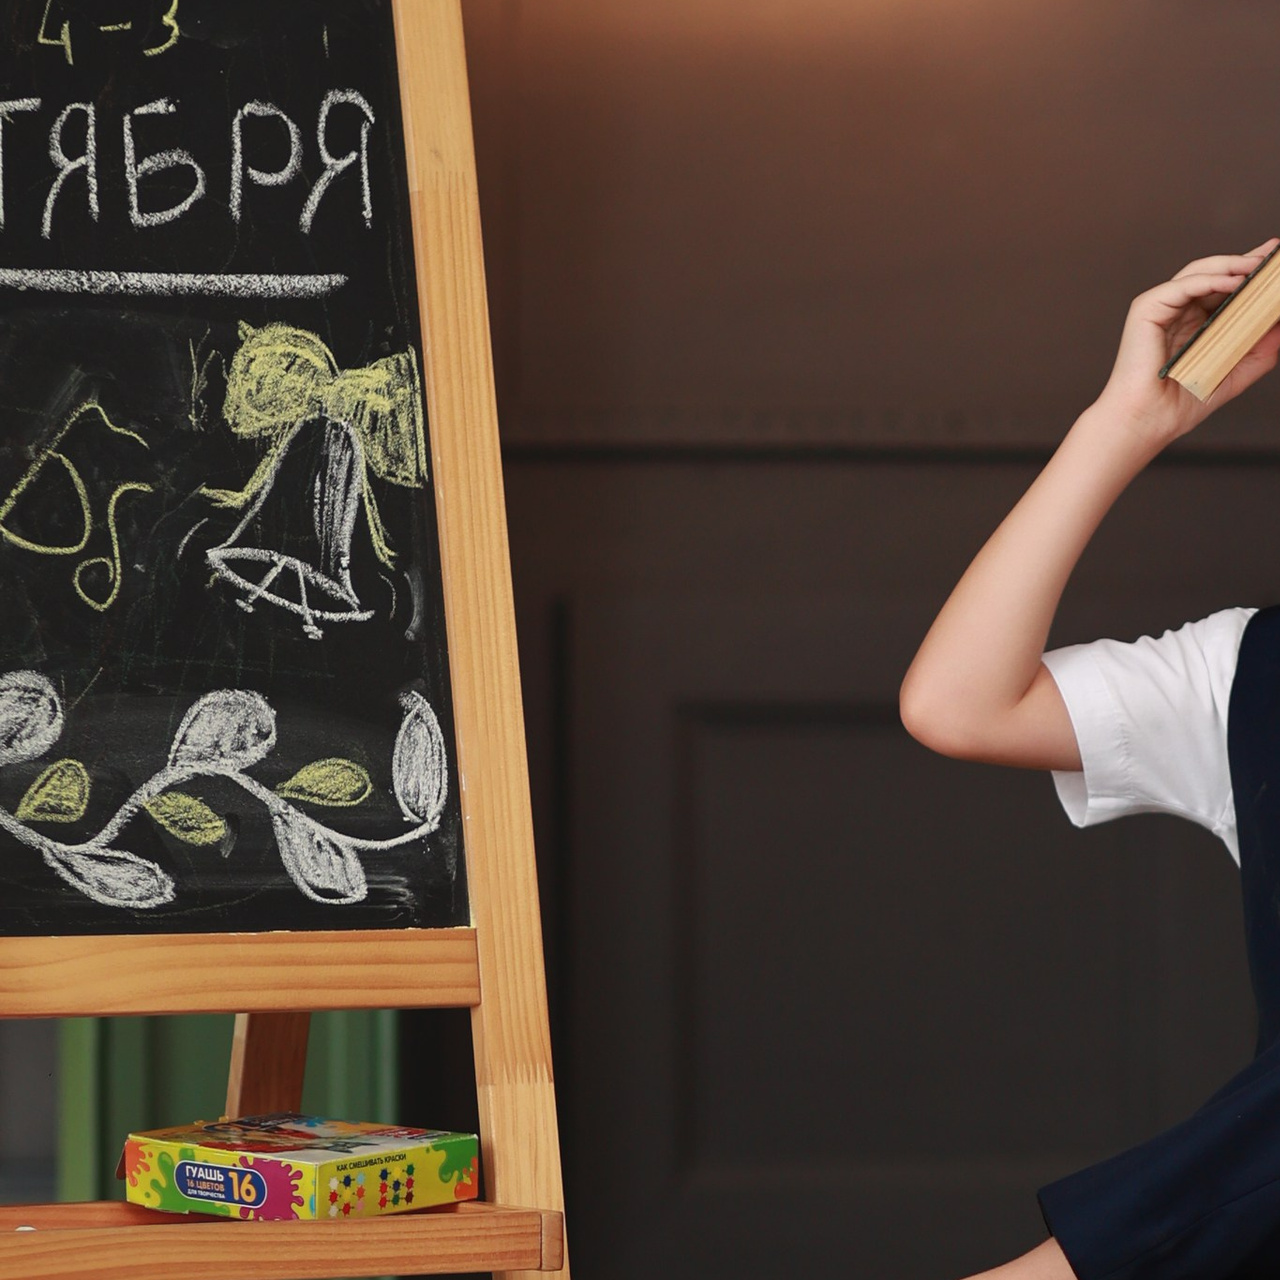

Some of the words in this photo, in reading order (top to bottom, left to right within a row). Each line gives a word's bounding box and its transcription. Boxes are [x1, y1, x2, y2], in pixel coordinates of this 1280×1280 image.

[336, 1164, 348, 1172] КАК
[348, 1157, 384, 1170] СМЕШИВАТЬ
[384, 1153, 407, 1164] КРАСКИ
[185, 1165, 225, 1182] ГУАШЬ
[186, 1179, 195, 1188] 16
[196, 1181, 225, 1192] ЦВЕТОВ
[228, 1171, 257, 1203] 16
